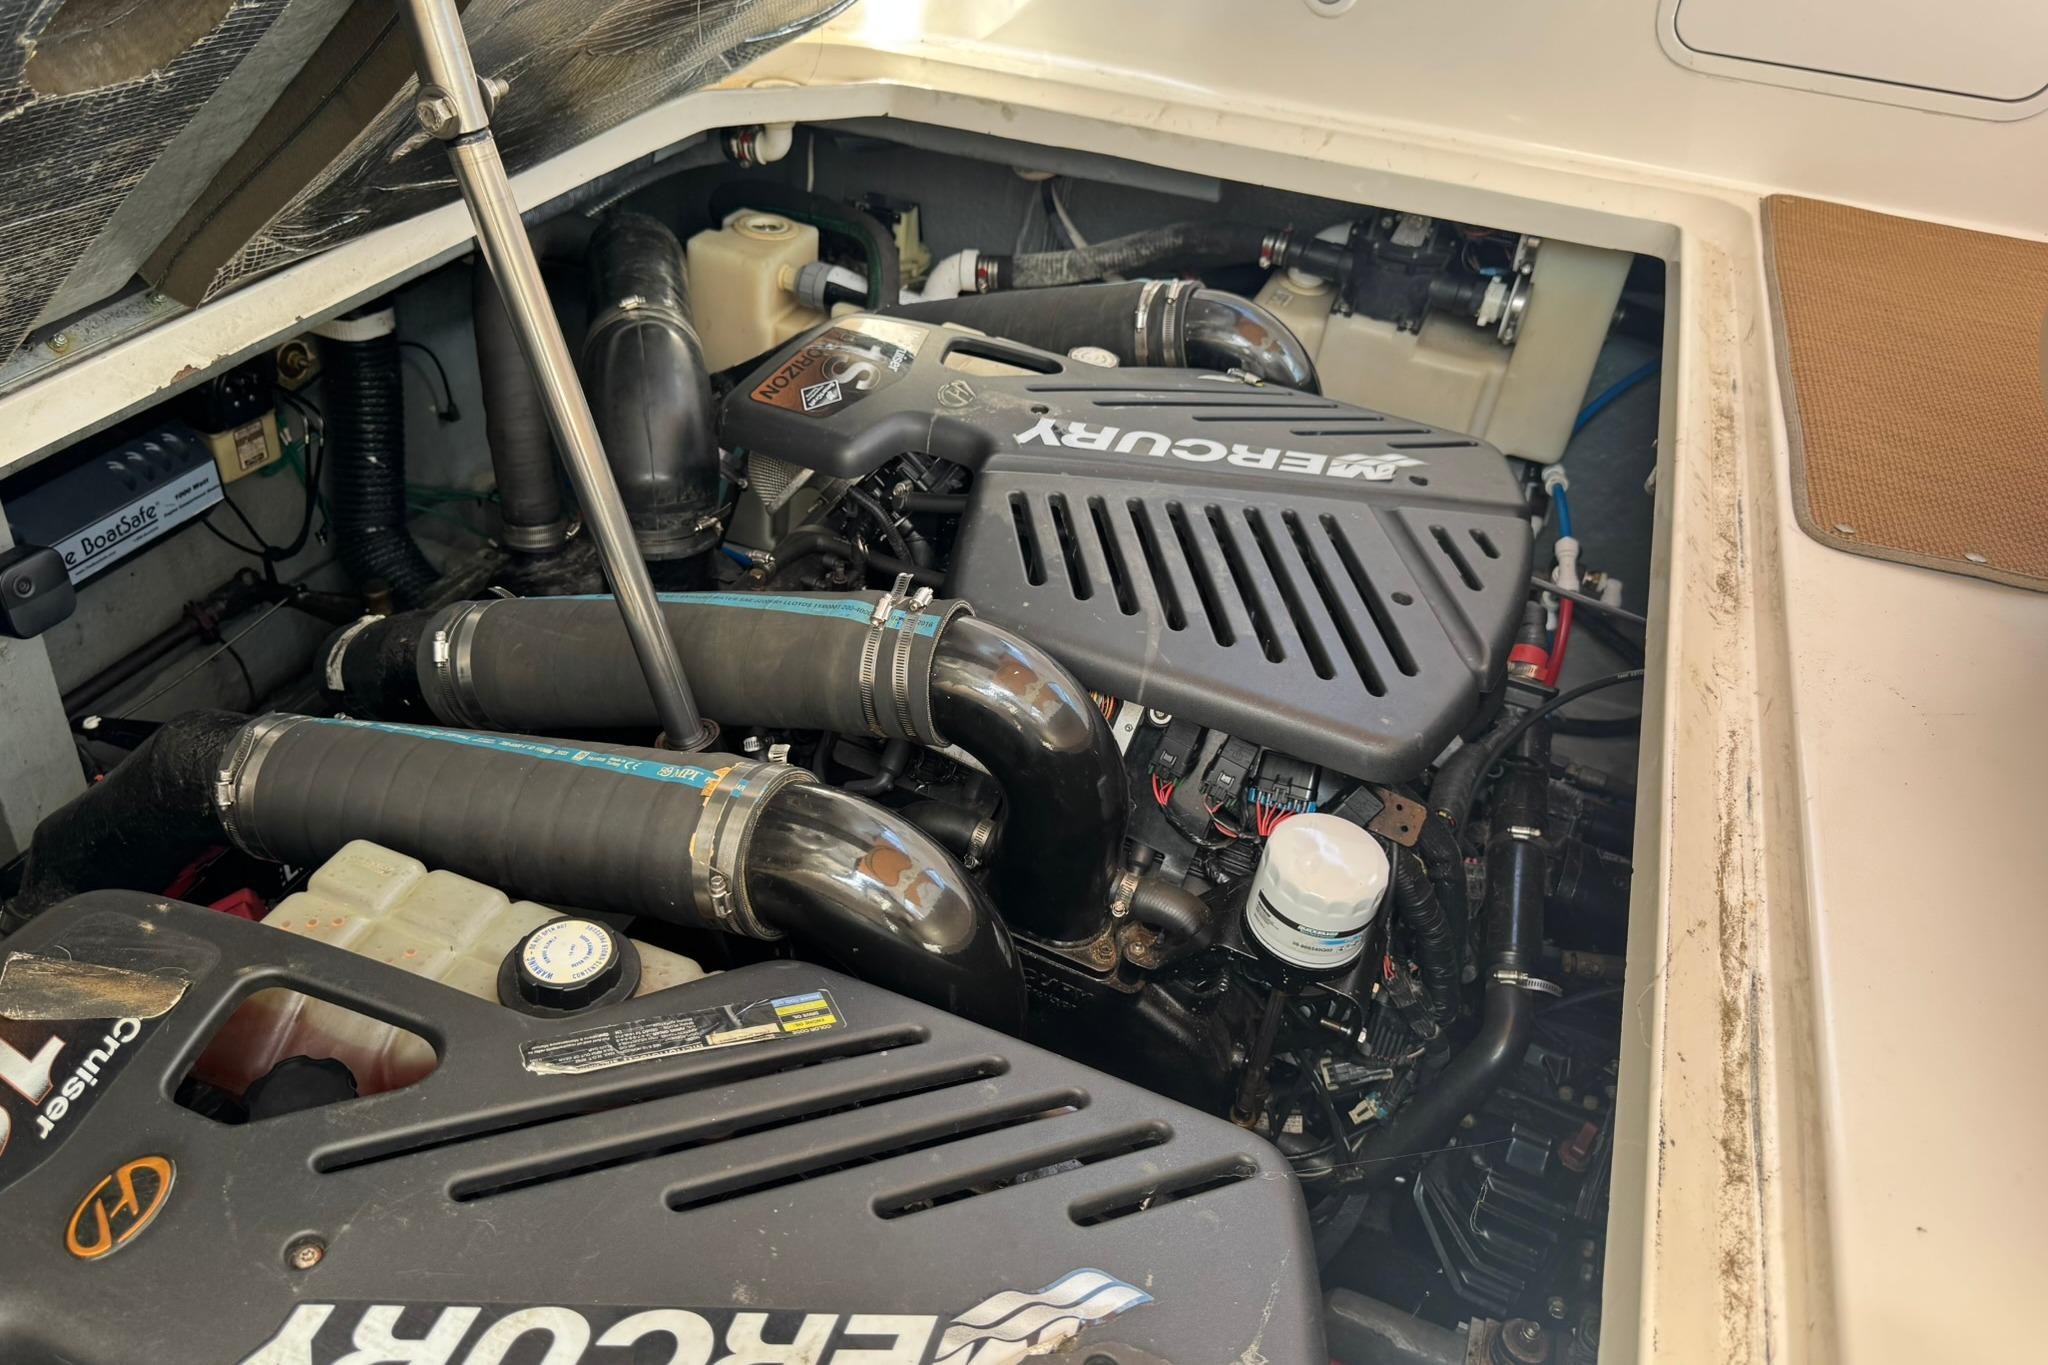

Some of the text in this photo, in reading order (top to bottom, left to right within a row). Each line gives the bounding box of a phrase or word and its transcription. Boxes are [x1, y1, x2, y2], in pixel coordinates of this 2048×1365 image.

[760, 348, 824, 401] ORIZON
[1013, 418, 1399, 483] MERCURY
[80, 503, 158, 556] BoatSafe
